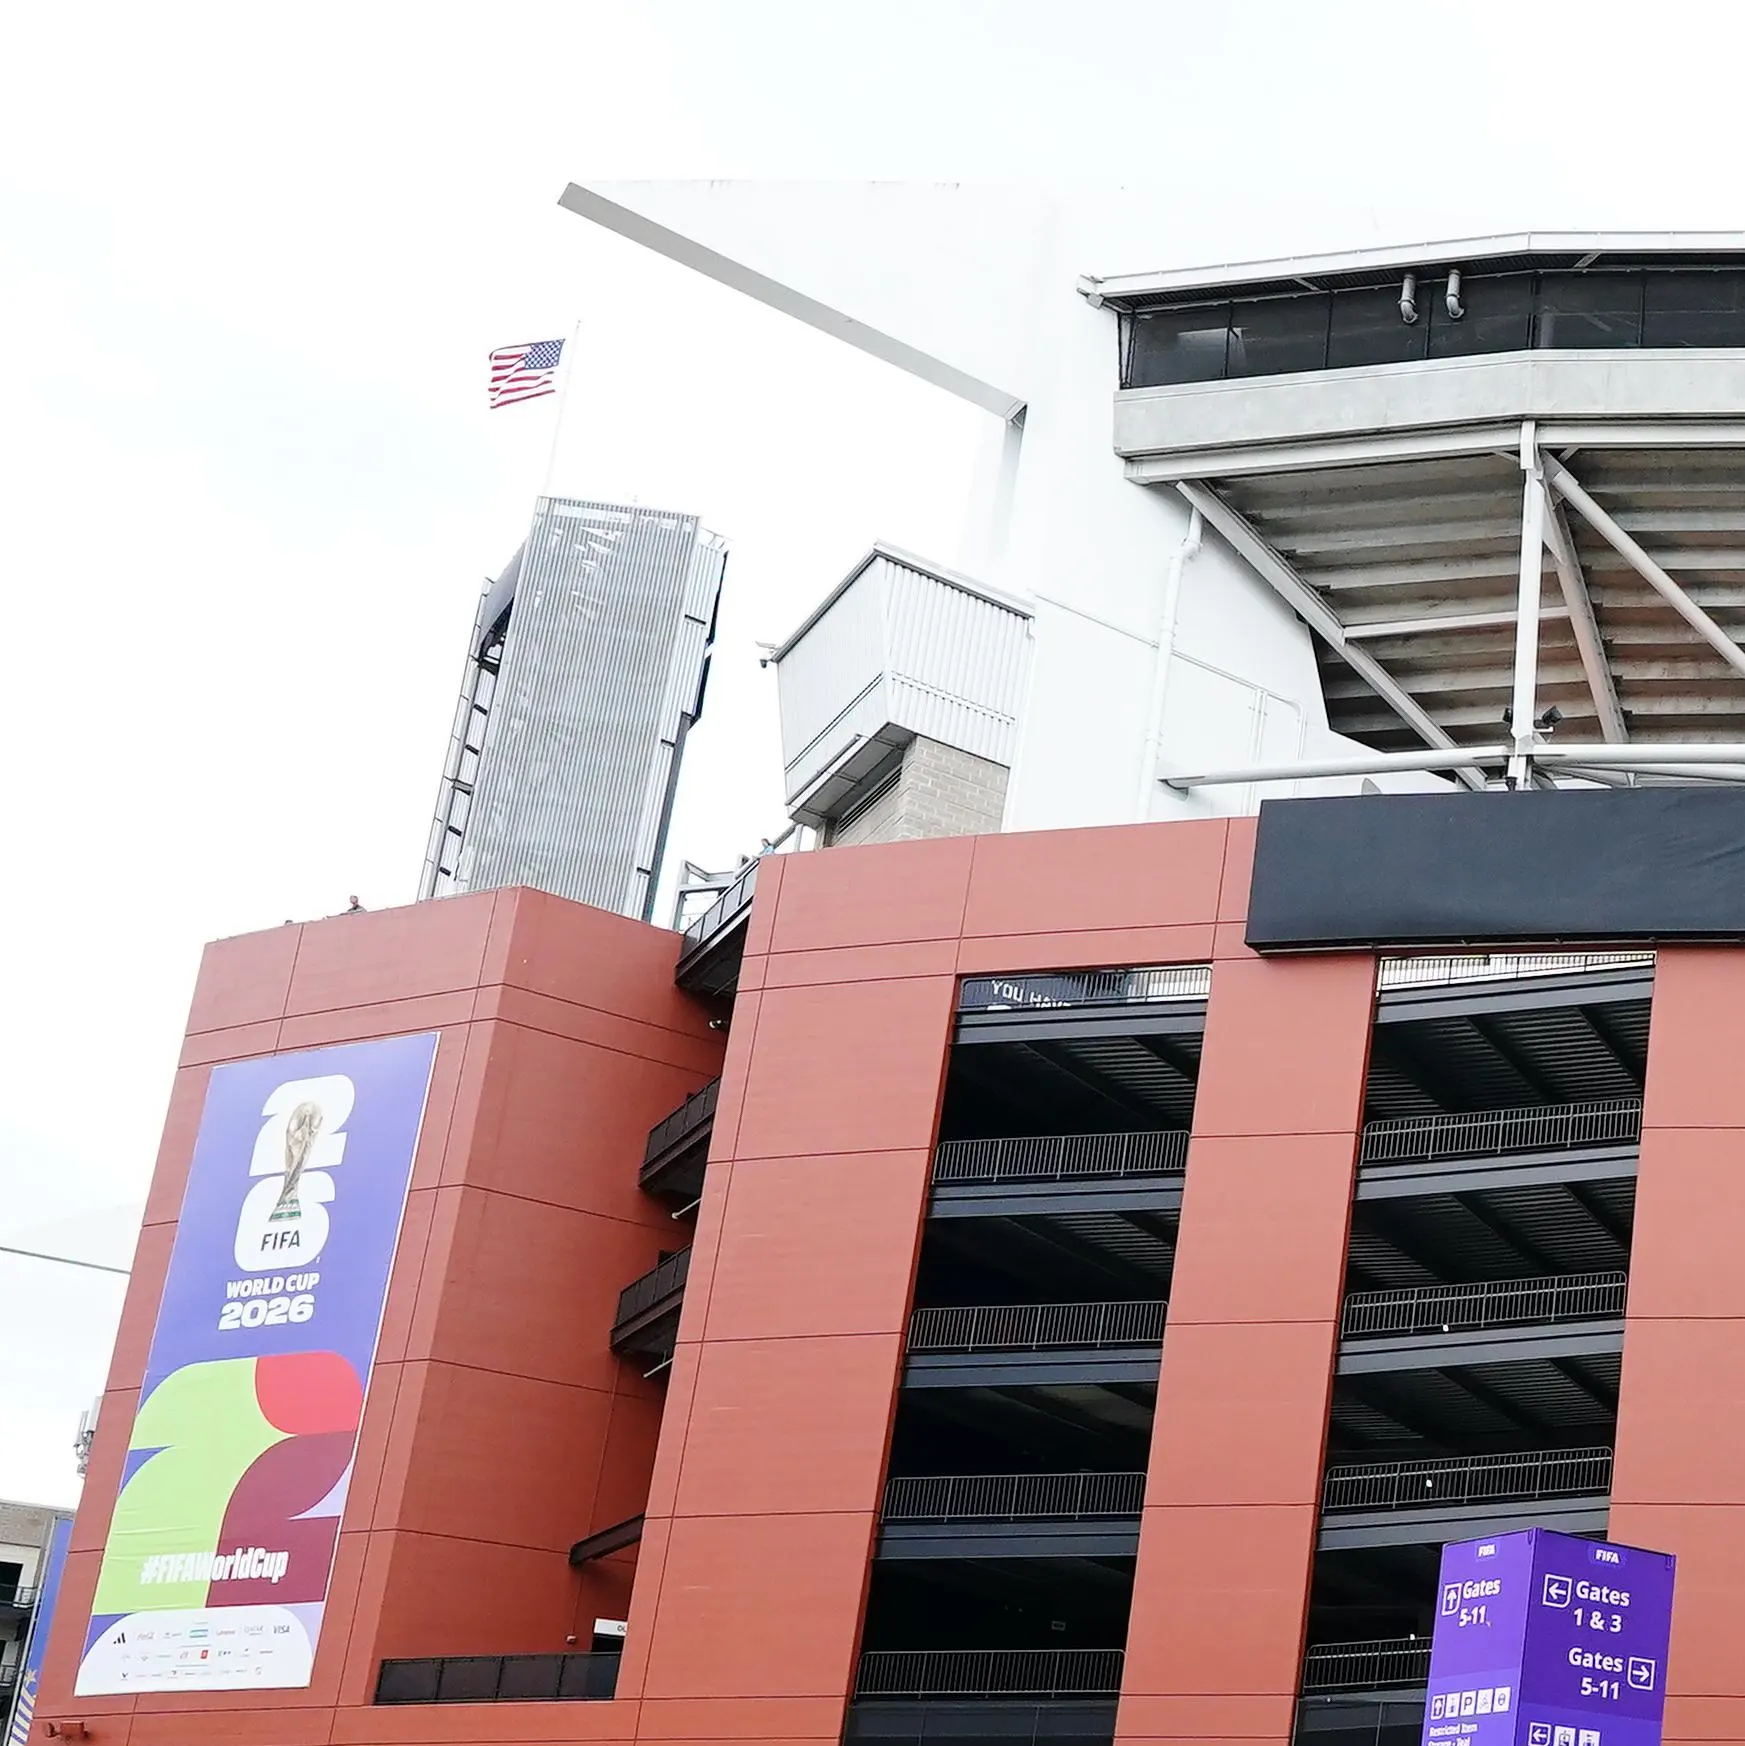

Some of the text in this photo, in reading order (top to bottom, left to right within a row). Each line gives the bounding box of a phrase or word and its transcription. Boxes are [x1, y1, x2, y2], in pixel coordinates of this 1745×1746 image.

[260, 1230, 301, 1251] FIFA
[226, 1272, 320, 1299] WORLD CUP
[218, 1294, 315, 1331] 2026
[140, 1547, 289, 1585] #FIFAWorldCup
[1596, 1550, 1619, 1564] FIFA
[1462, 1578, 1501, 1600] Gates
[1575, 1580, 1631, 1607] Gates
[1459, 1605, 1487, 1628] 5-11
[1574, 1608, 1623, 1633] 1 & 3
[1568, 1647, 1624, 1674] Gates
[1580, 1677, 1620, 1700] 5-11
